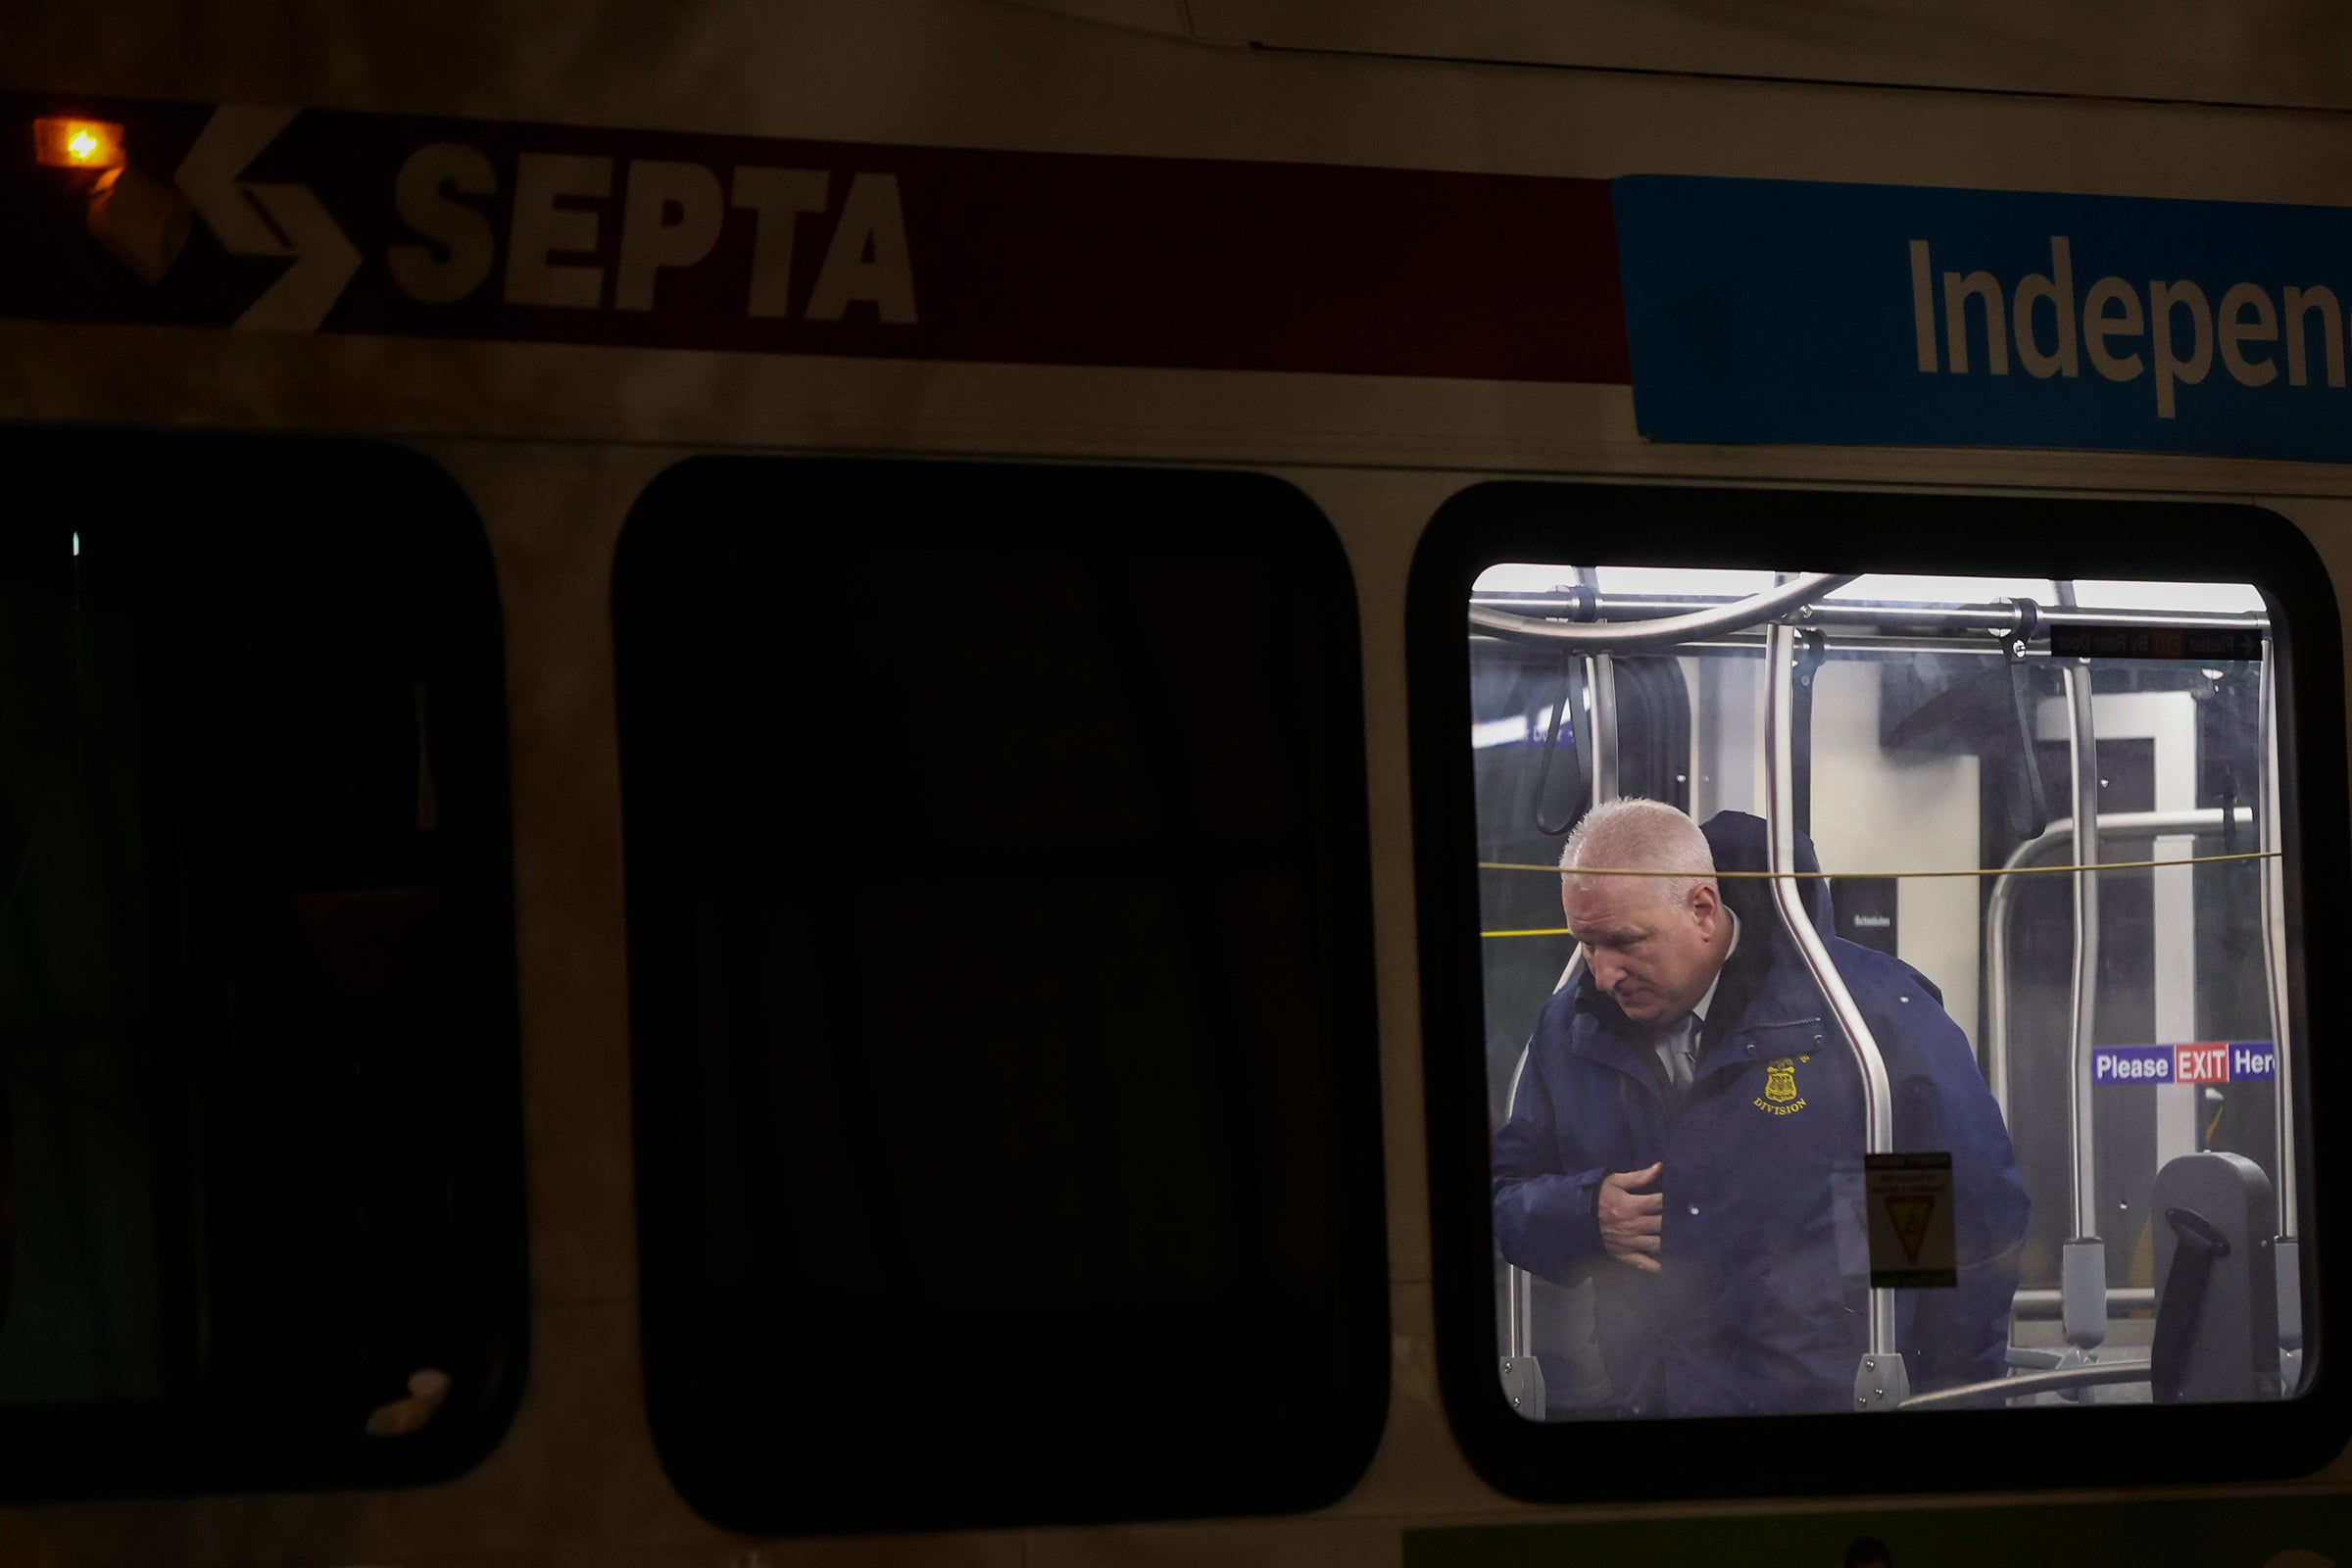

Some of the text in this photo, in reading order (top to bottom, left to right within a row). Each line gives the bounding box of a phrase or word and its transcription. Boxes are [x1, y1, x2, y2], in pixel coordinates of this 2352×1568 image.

[385, 140, 920, 325] SEPTA
[1908, 234, 2352, 419] Indepen
[1752, 1097, 1807, 1115] DIVISION
[2095, 1049, 2276, 1080] Please EXIT Her
